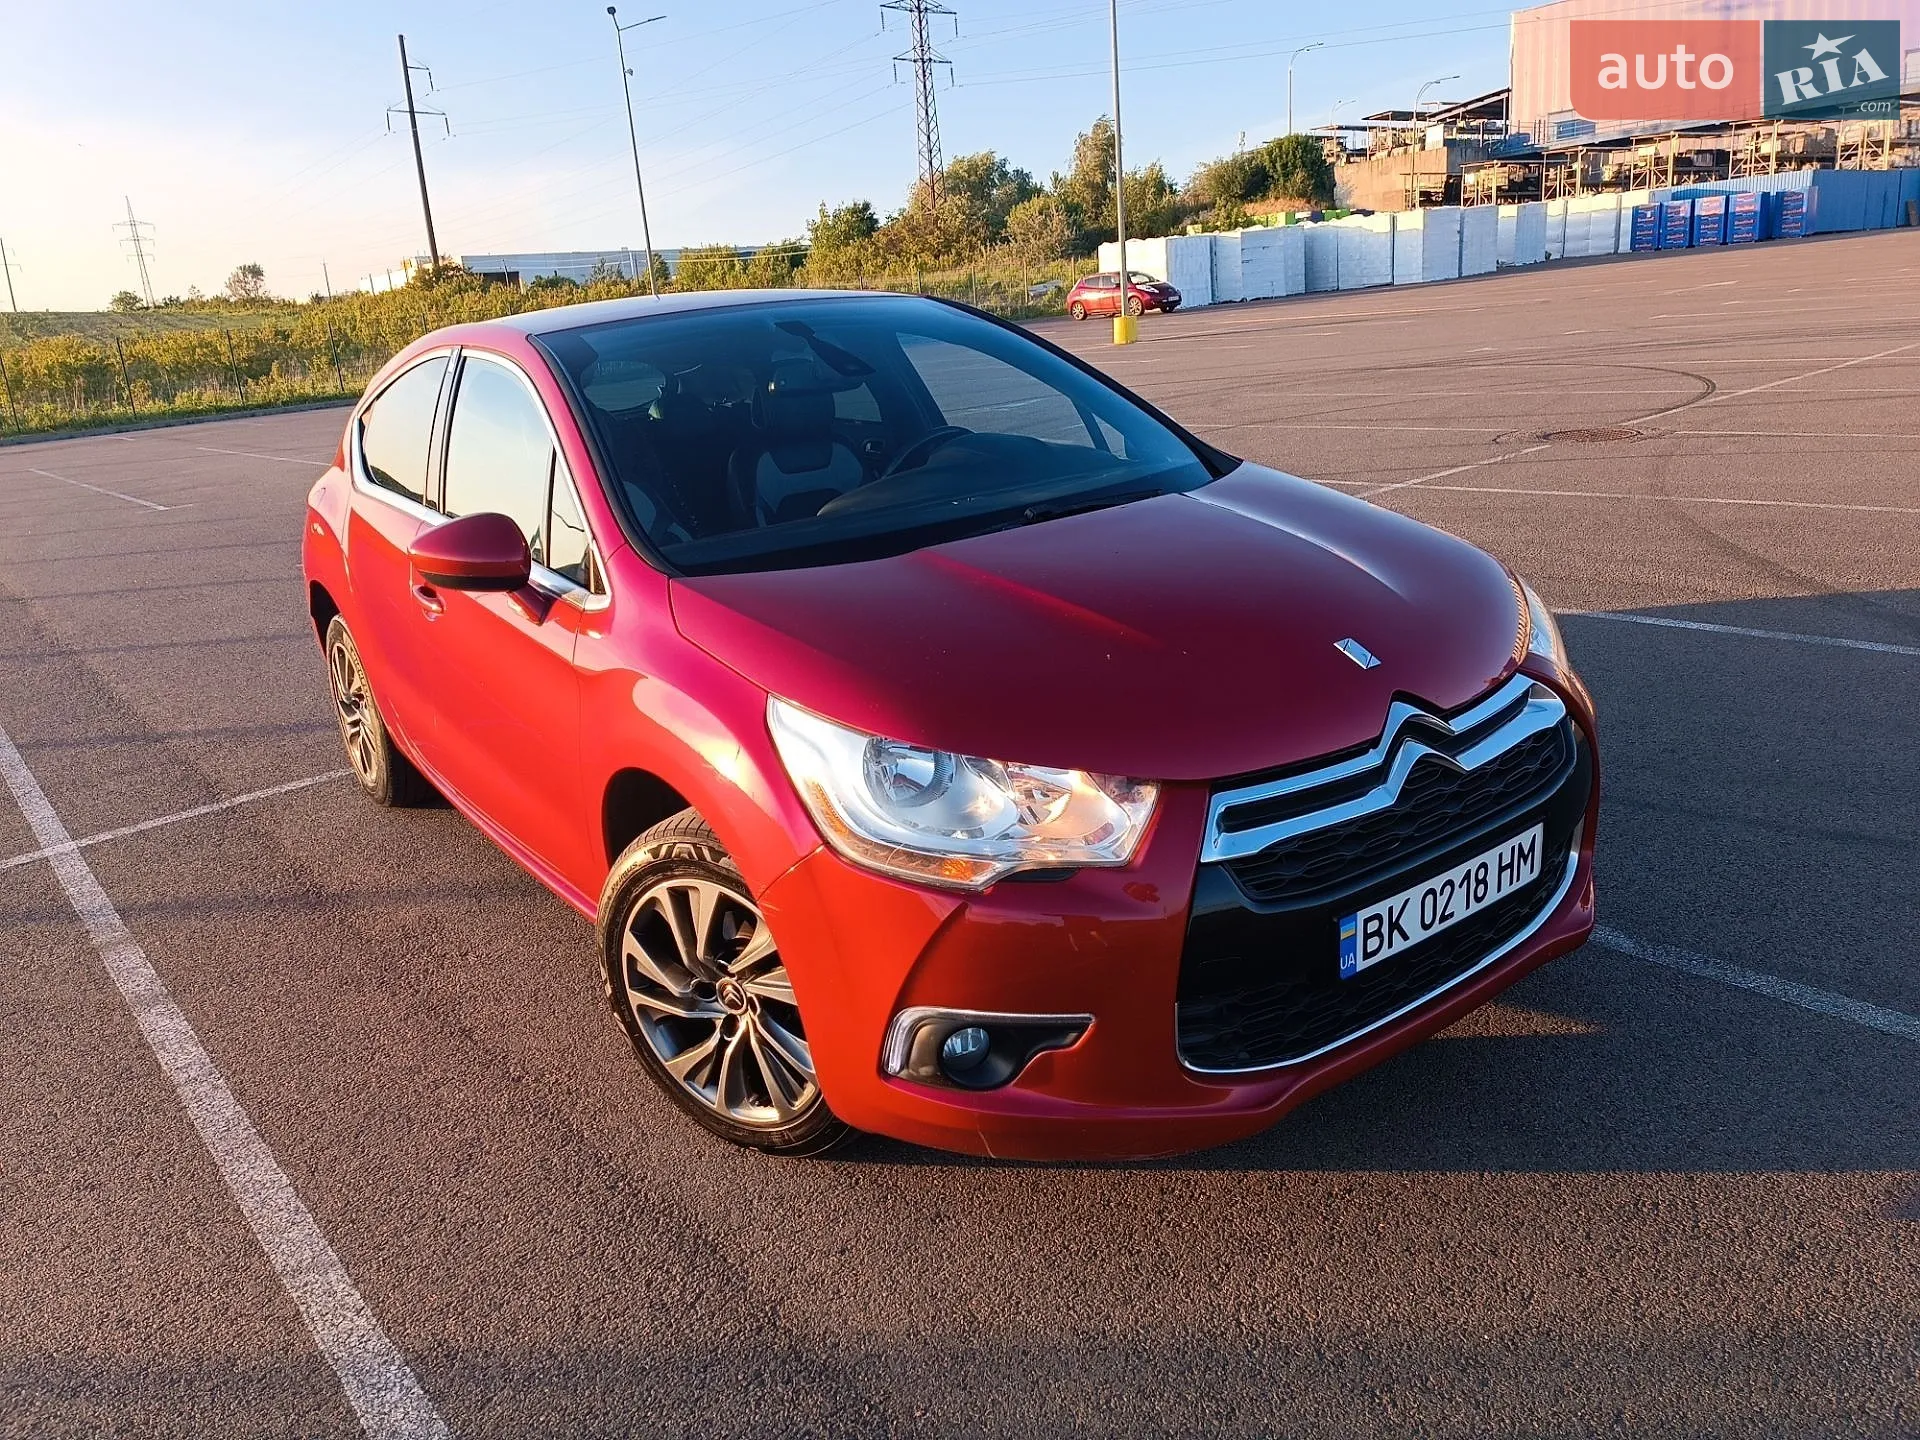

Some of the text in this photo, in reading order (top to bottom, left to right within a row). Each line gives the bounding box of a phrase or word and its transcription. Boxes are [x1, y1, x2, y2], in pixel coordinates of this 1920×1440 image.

[1362, 833, 1537, 962] BK 0218 HM
[1340, 952, 1355, 970] UA
